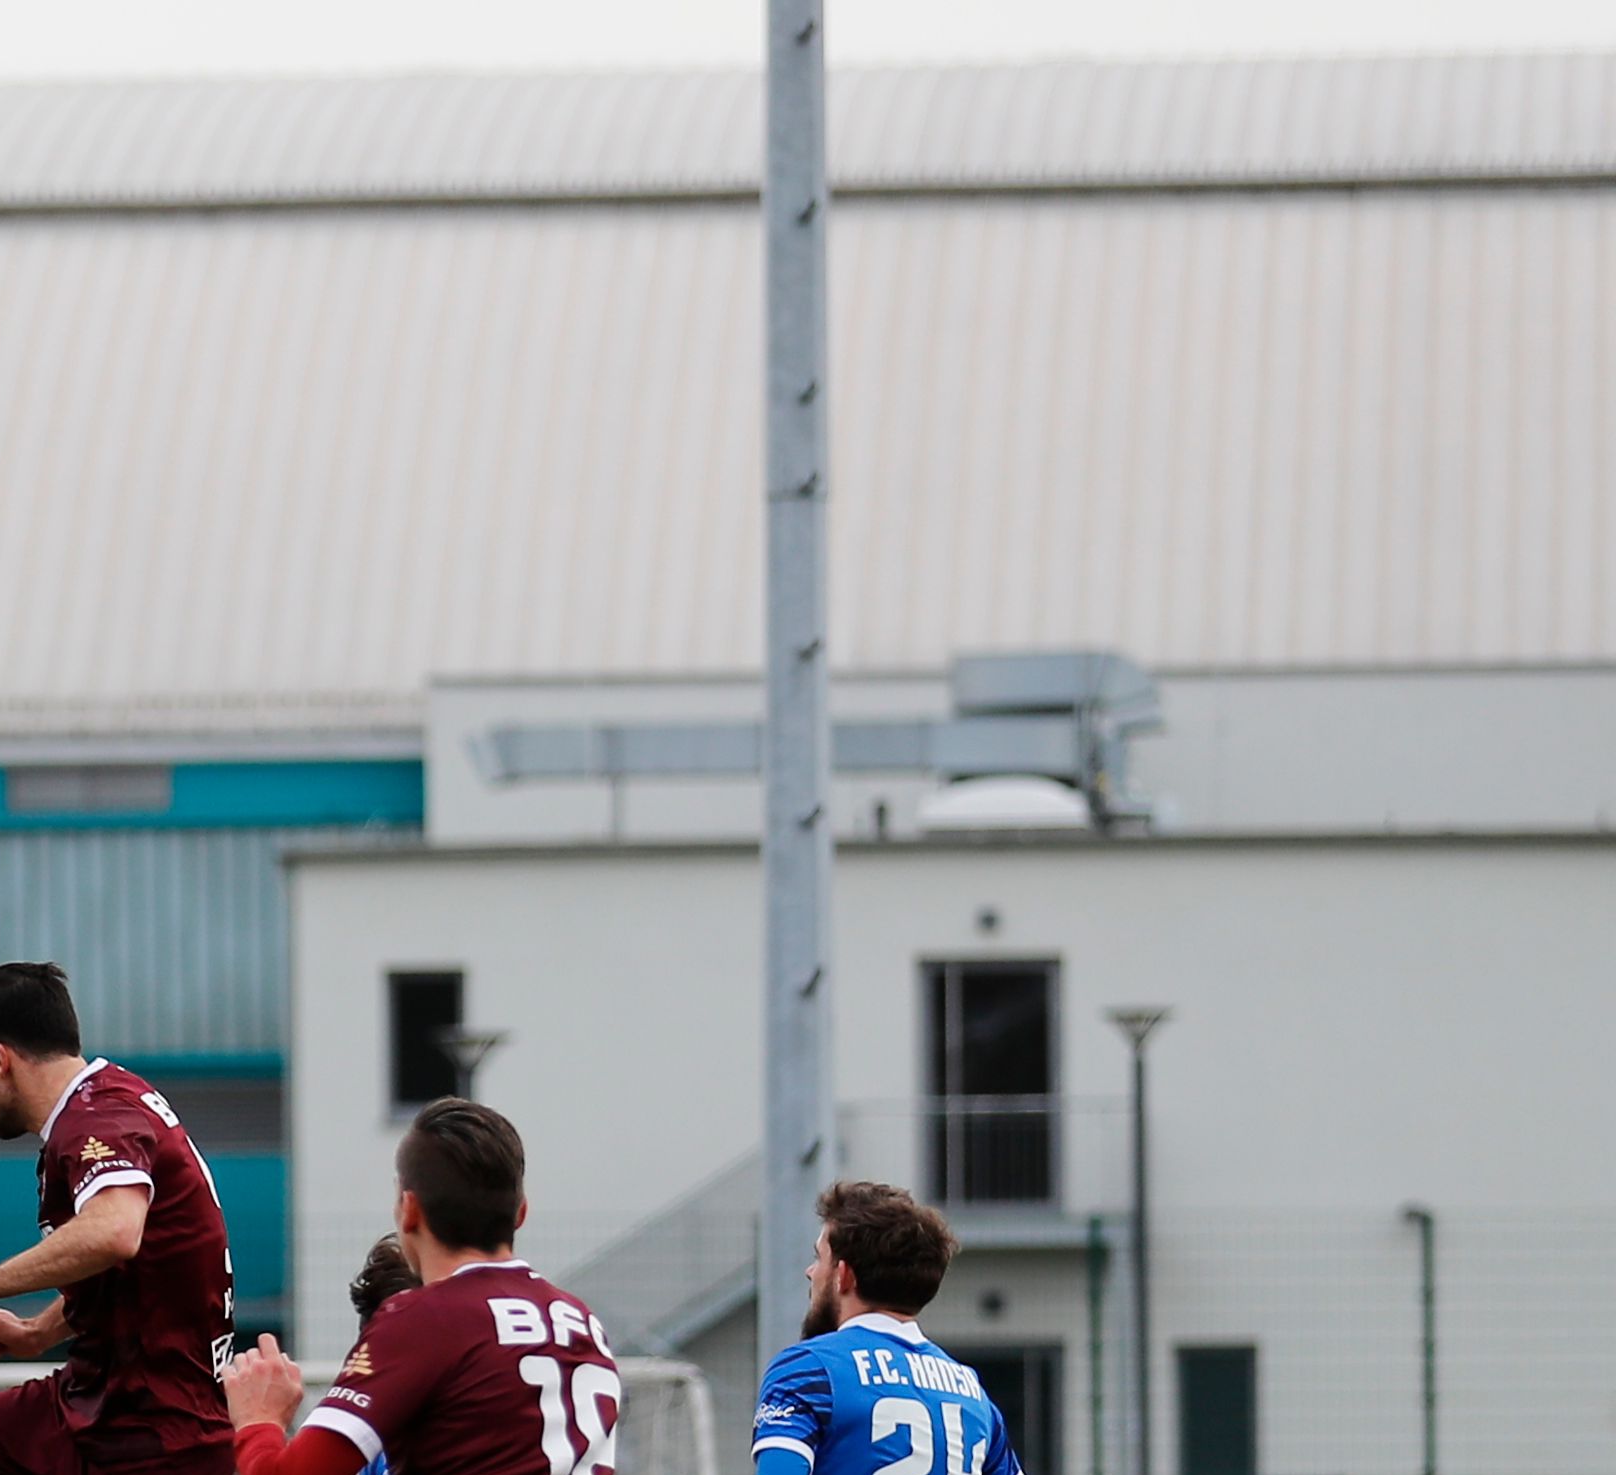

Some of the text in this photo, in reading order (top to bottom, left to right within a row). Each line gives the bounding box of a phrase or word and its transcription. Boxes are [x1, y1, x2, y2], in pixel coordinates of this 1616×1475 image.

[851, 1349, 982, 1402] F.C. HANSA
[327, 1385, 372, 1409] BAG
